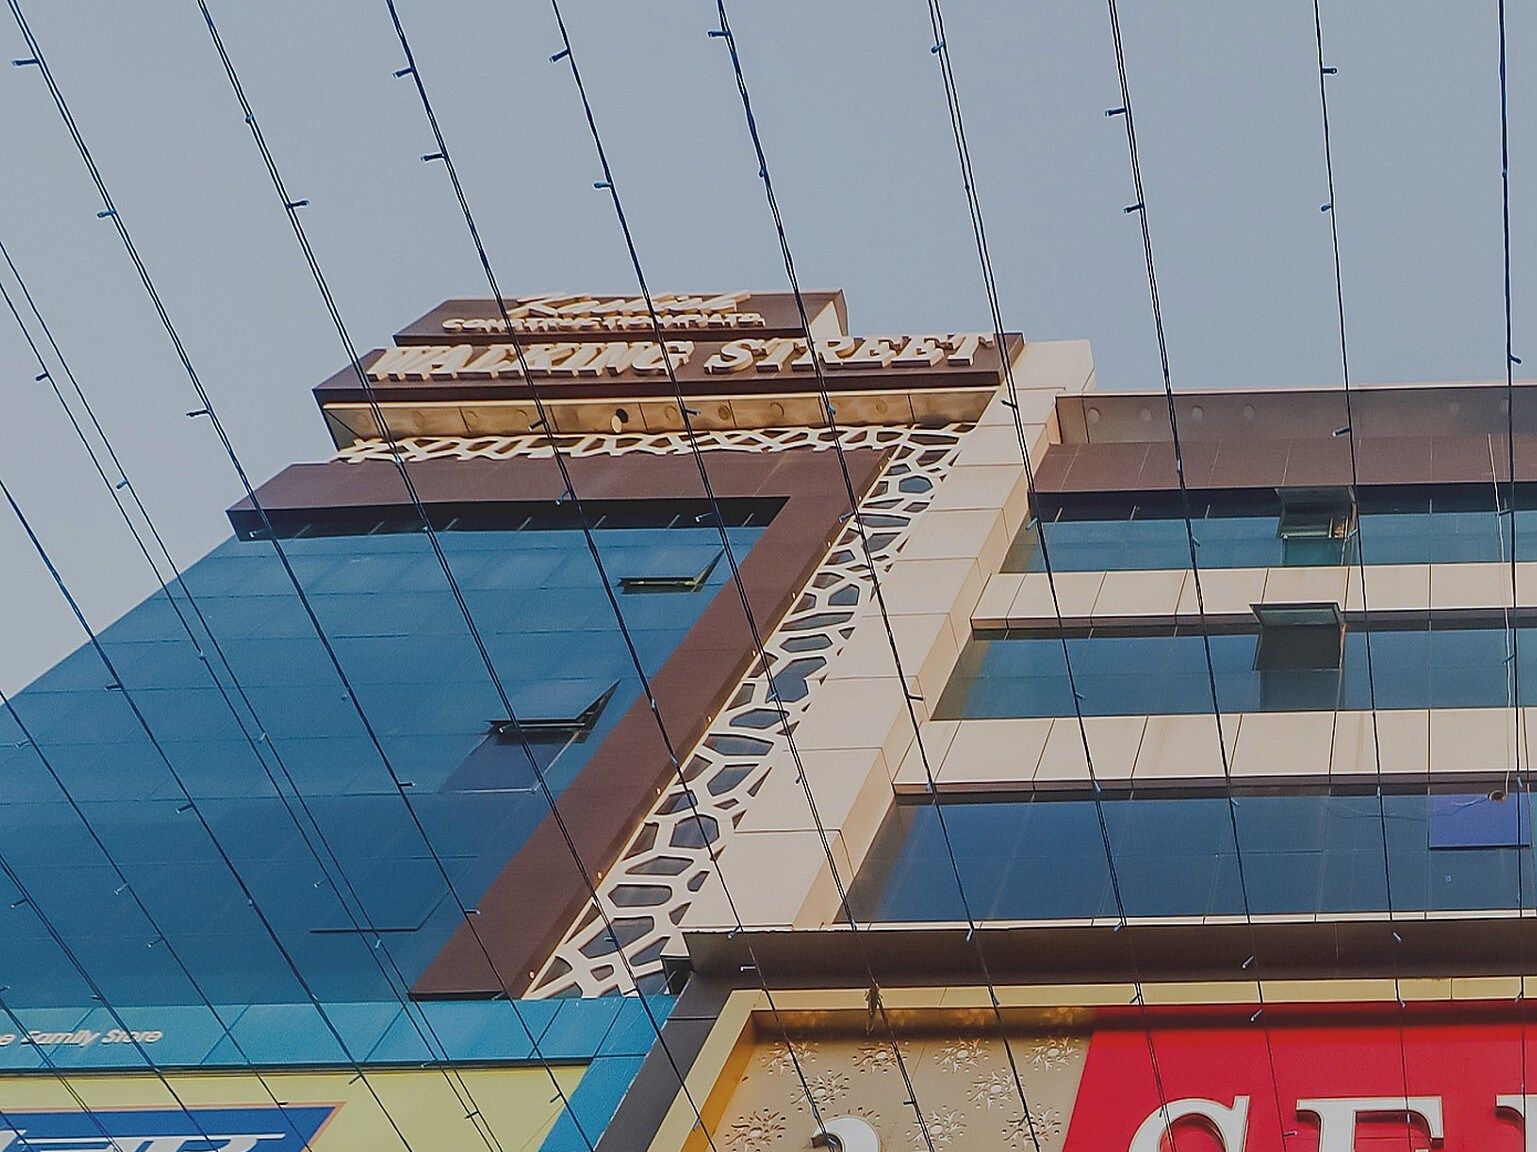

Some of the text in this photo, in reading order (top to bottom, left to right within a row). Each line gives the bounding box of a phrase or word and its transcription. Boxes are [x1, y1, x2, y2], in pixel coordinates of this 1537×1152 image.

[365, 333, 996, 380] WALKING STREET
[21, 1030, 100, 1047] Family
[102, 1029, 162, 1044] Store
